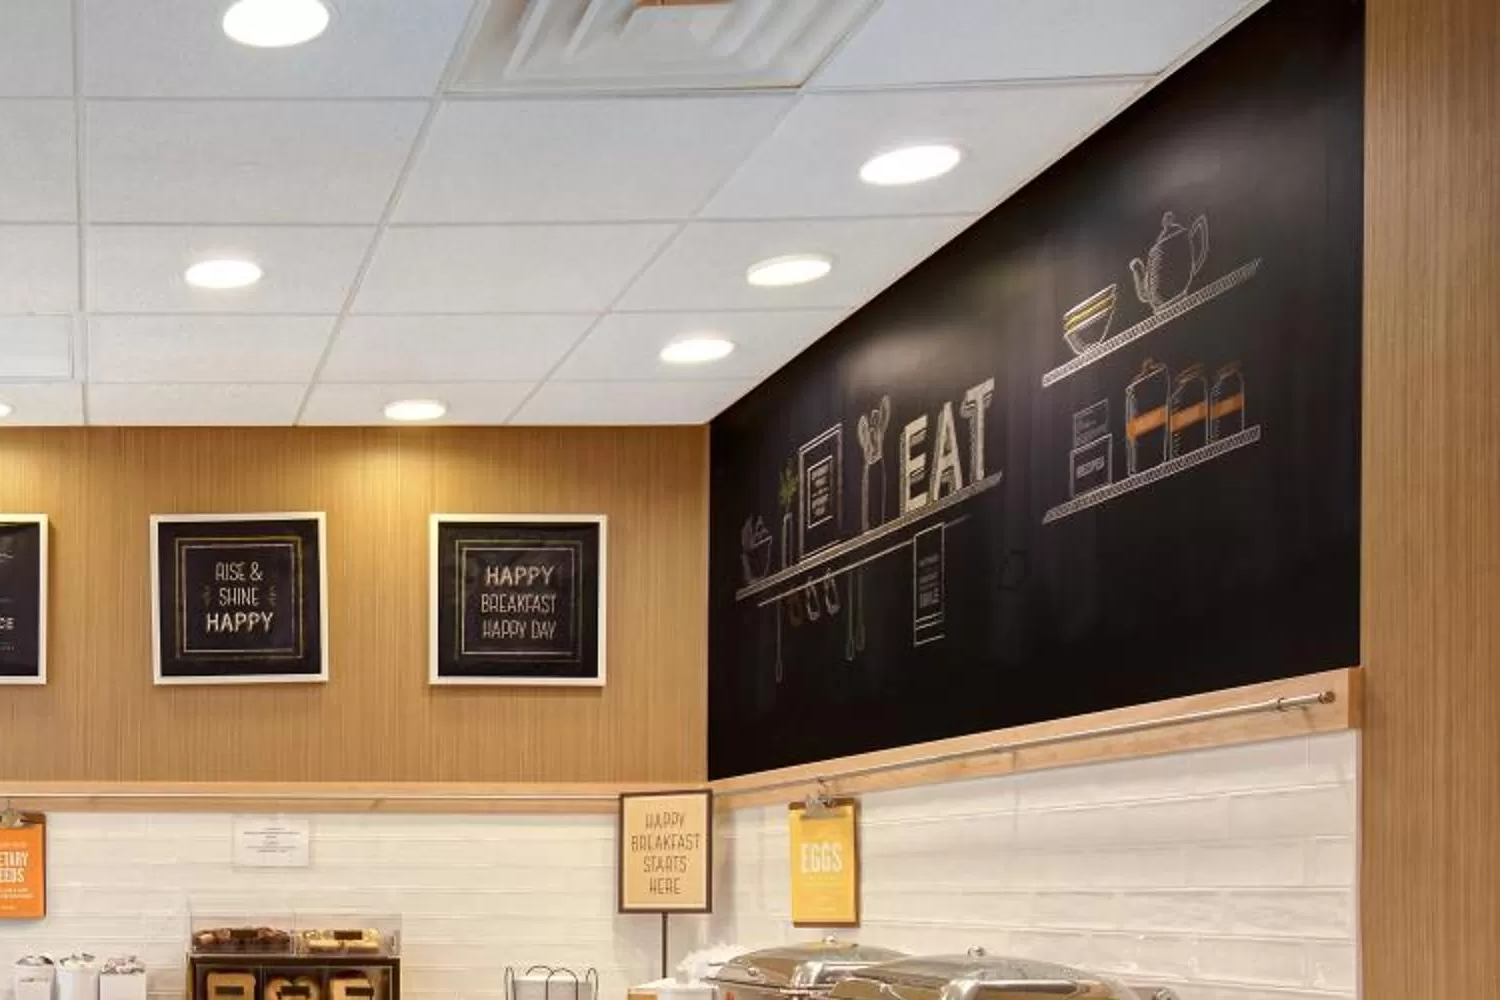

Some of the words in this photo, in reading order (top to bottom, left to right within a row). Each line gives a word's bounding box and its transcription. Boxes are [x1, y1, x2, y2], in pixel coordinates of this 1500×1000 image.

[900, 378, 995, 513] EAT
[215, 561, 245, 581] RISE
[250, 561, 263, 581] &
[485, 565, 553, 586] HAPPY
[219, 587, 260, 606] SHINE
[481, 593, 556, 613] BREAKFAST
[206, 611, 273, 633] HAPPY
[483, 619, 527, 639] HAPPY
[531, 619, 557, 640] DAY
[645, 811, 686, 829] HAPPY
[631, 833, 700, 852] BREAKFAST
[643, 855, 688, 873] STARTS
[801, 842, 842, 873] EGGS
[649, 876, 681, 895] HERE
